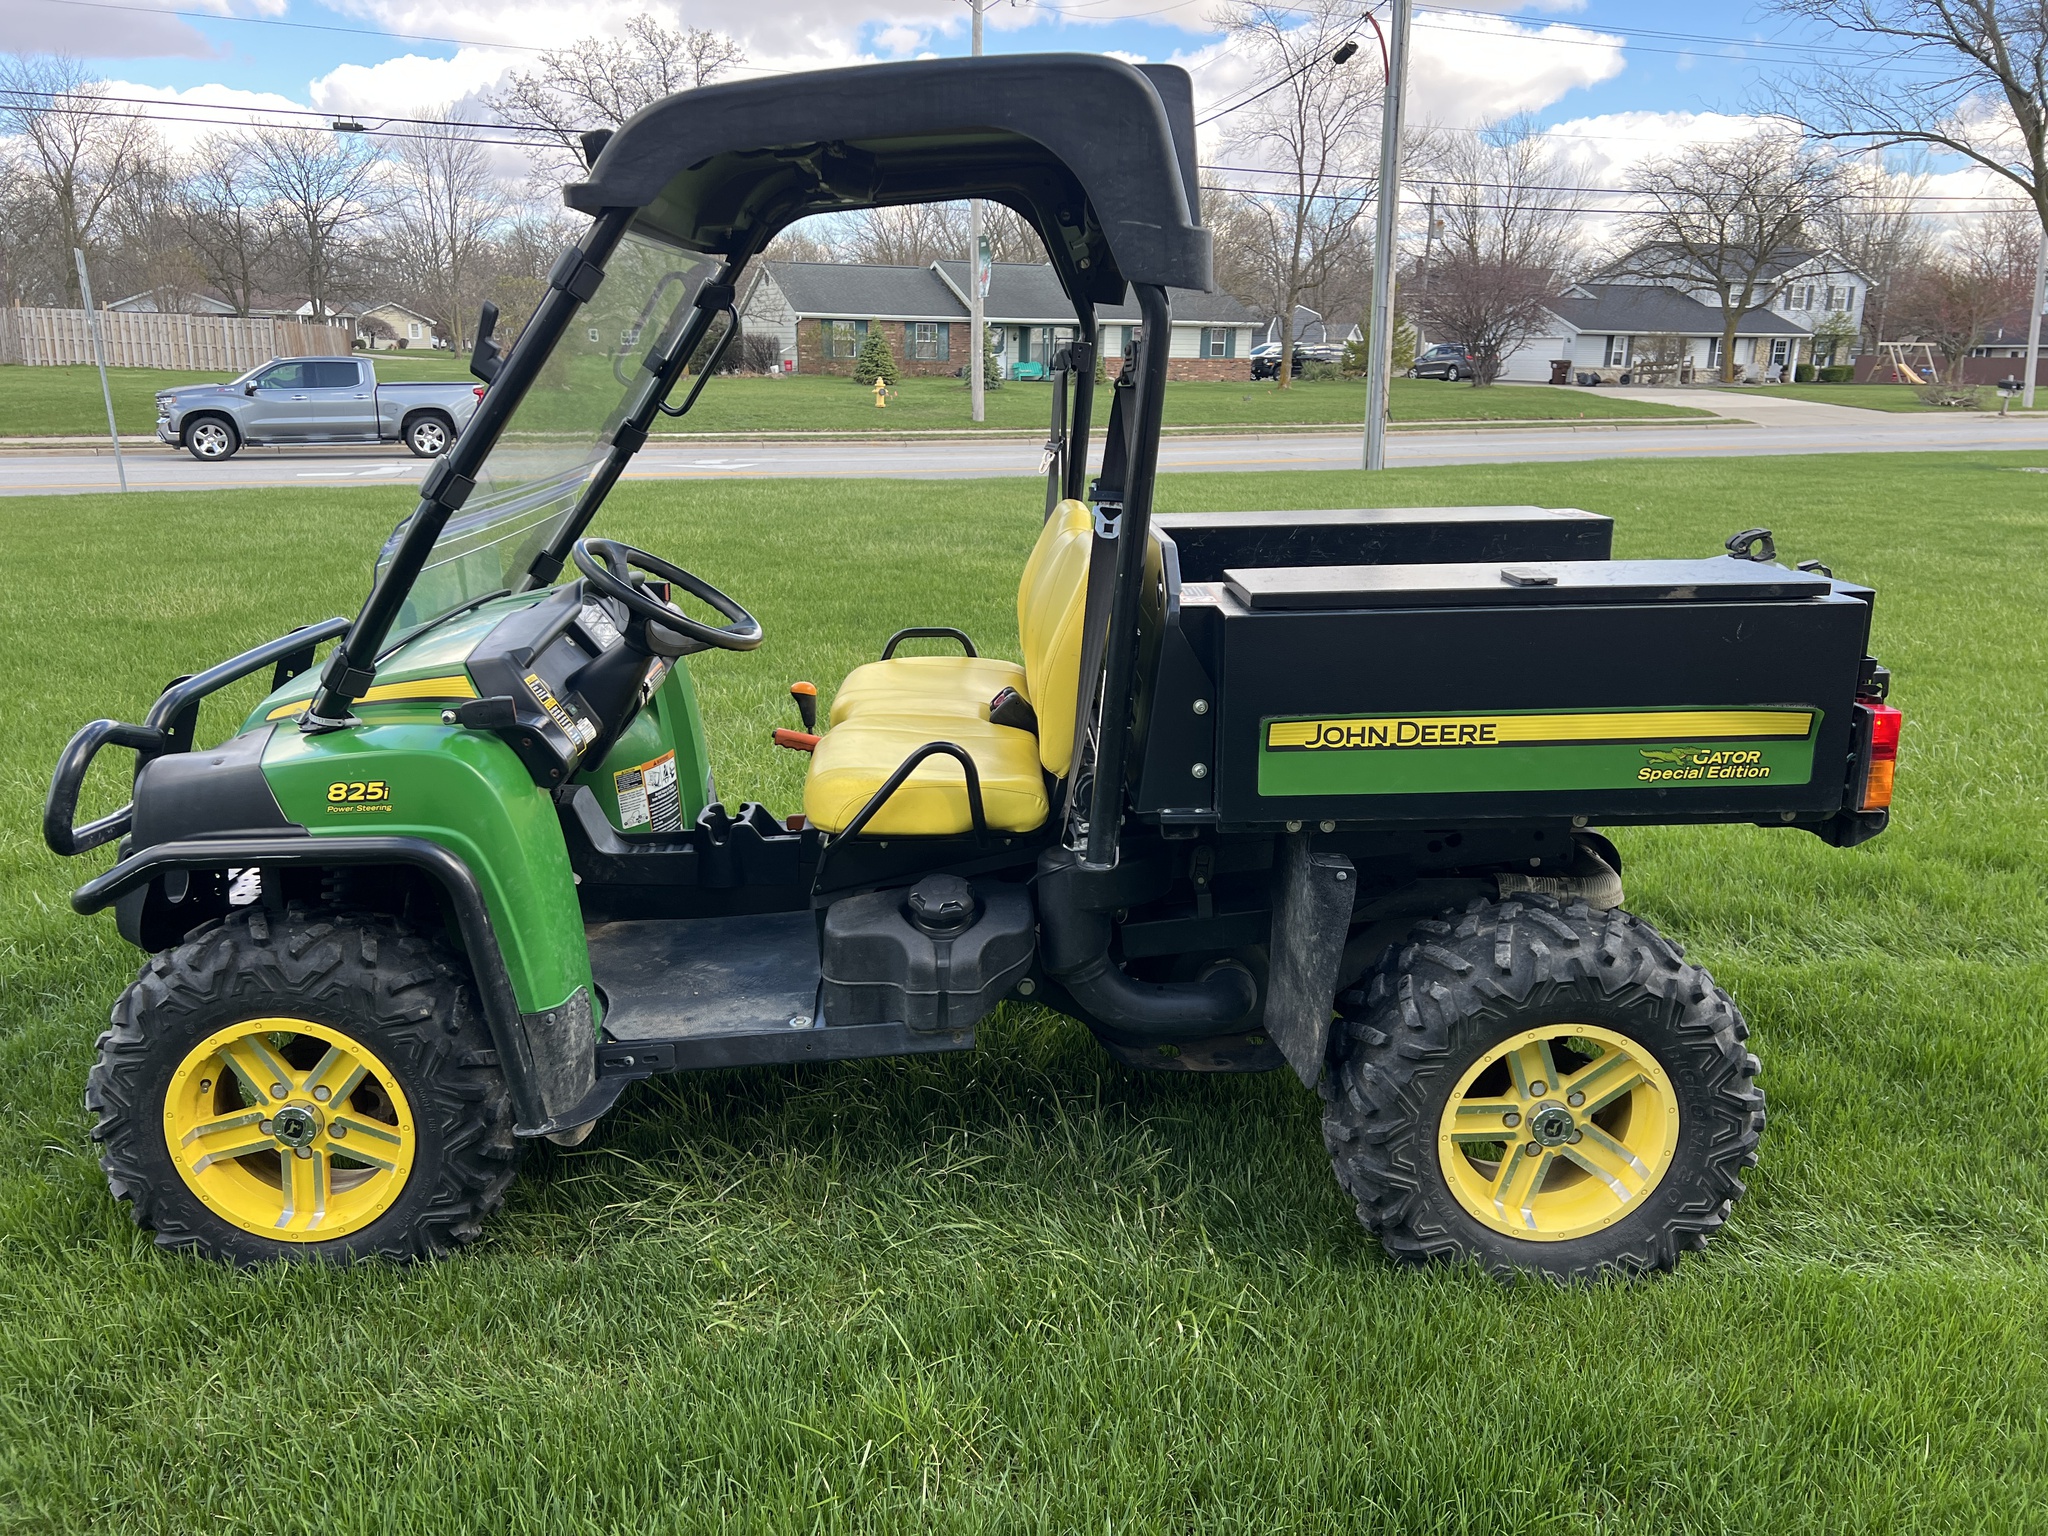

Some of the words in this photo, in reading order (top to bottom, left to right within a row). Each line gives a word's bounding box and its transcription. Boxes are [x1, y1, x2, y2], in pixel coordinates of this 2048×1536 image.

[1304, 723, 1389, 747] JOHN
[1397, 721, 1498, 744] DEERE
[1691, 748, 1761, 765] GATOR
[1637, 766, 1705, 782] Special
[1706, 765, 1771, 779] Edition
[326, 781, 390, 802] 825i
[326, 804, 355, 813] Power
[356, 803, 393, 813] Steering
